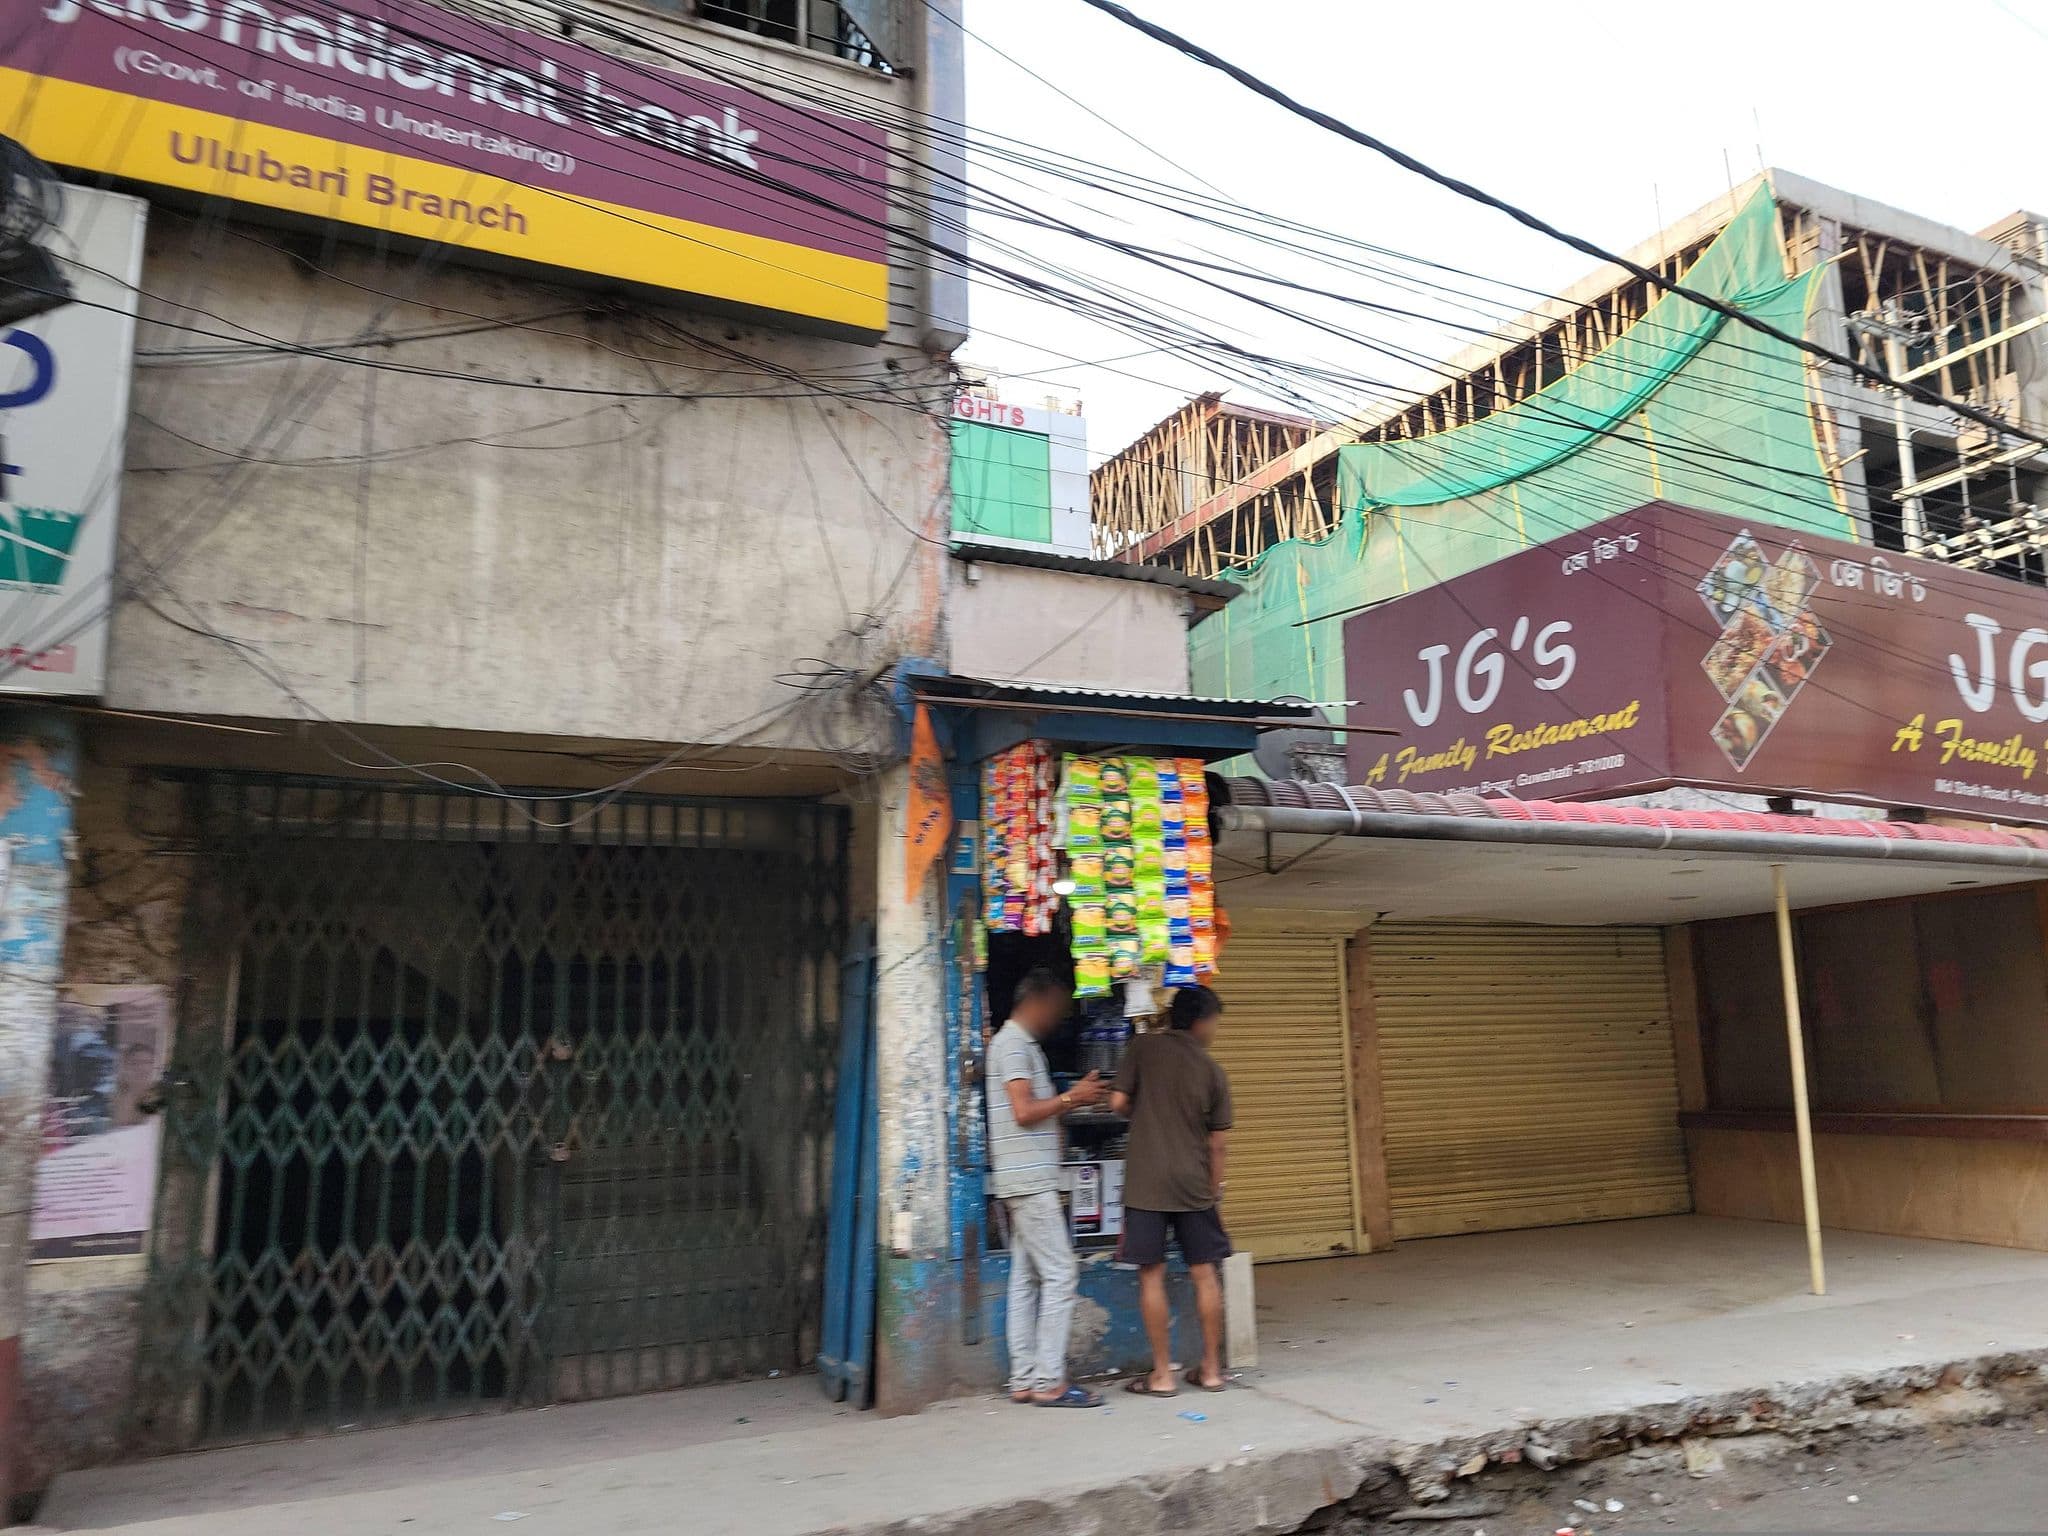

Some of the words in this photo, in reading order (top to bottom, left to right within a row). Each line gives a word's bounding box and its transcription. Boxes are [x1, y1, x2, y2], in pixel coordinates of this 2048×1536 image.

[113, 45, 228, 92] (Govt.
[237, 78, 277, 102] of
[283, 83, 367, 123] India
[375, 105, 576, 176] Undertaking)
[583, 69, 760, 171] bank
[169, 130, 349, 198] Ulubari
[364, 173, 529, 236] Branch
[1403, 616, 1577, 727] JG'S
[1366, 753, 1389, 786] A
[1395, 738, 1478, 784] Family
[1485, 700, 1640, 760] Restaurant
[1891, 713, 1926, 752] A
[1934, 718, 2038, 780] Family
